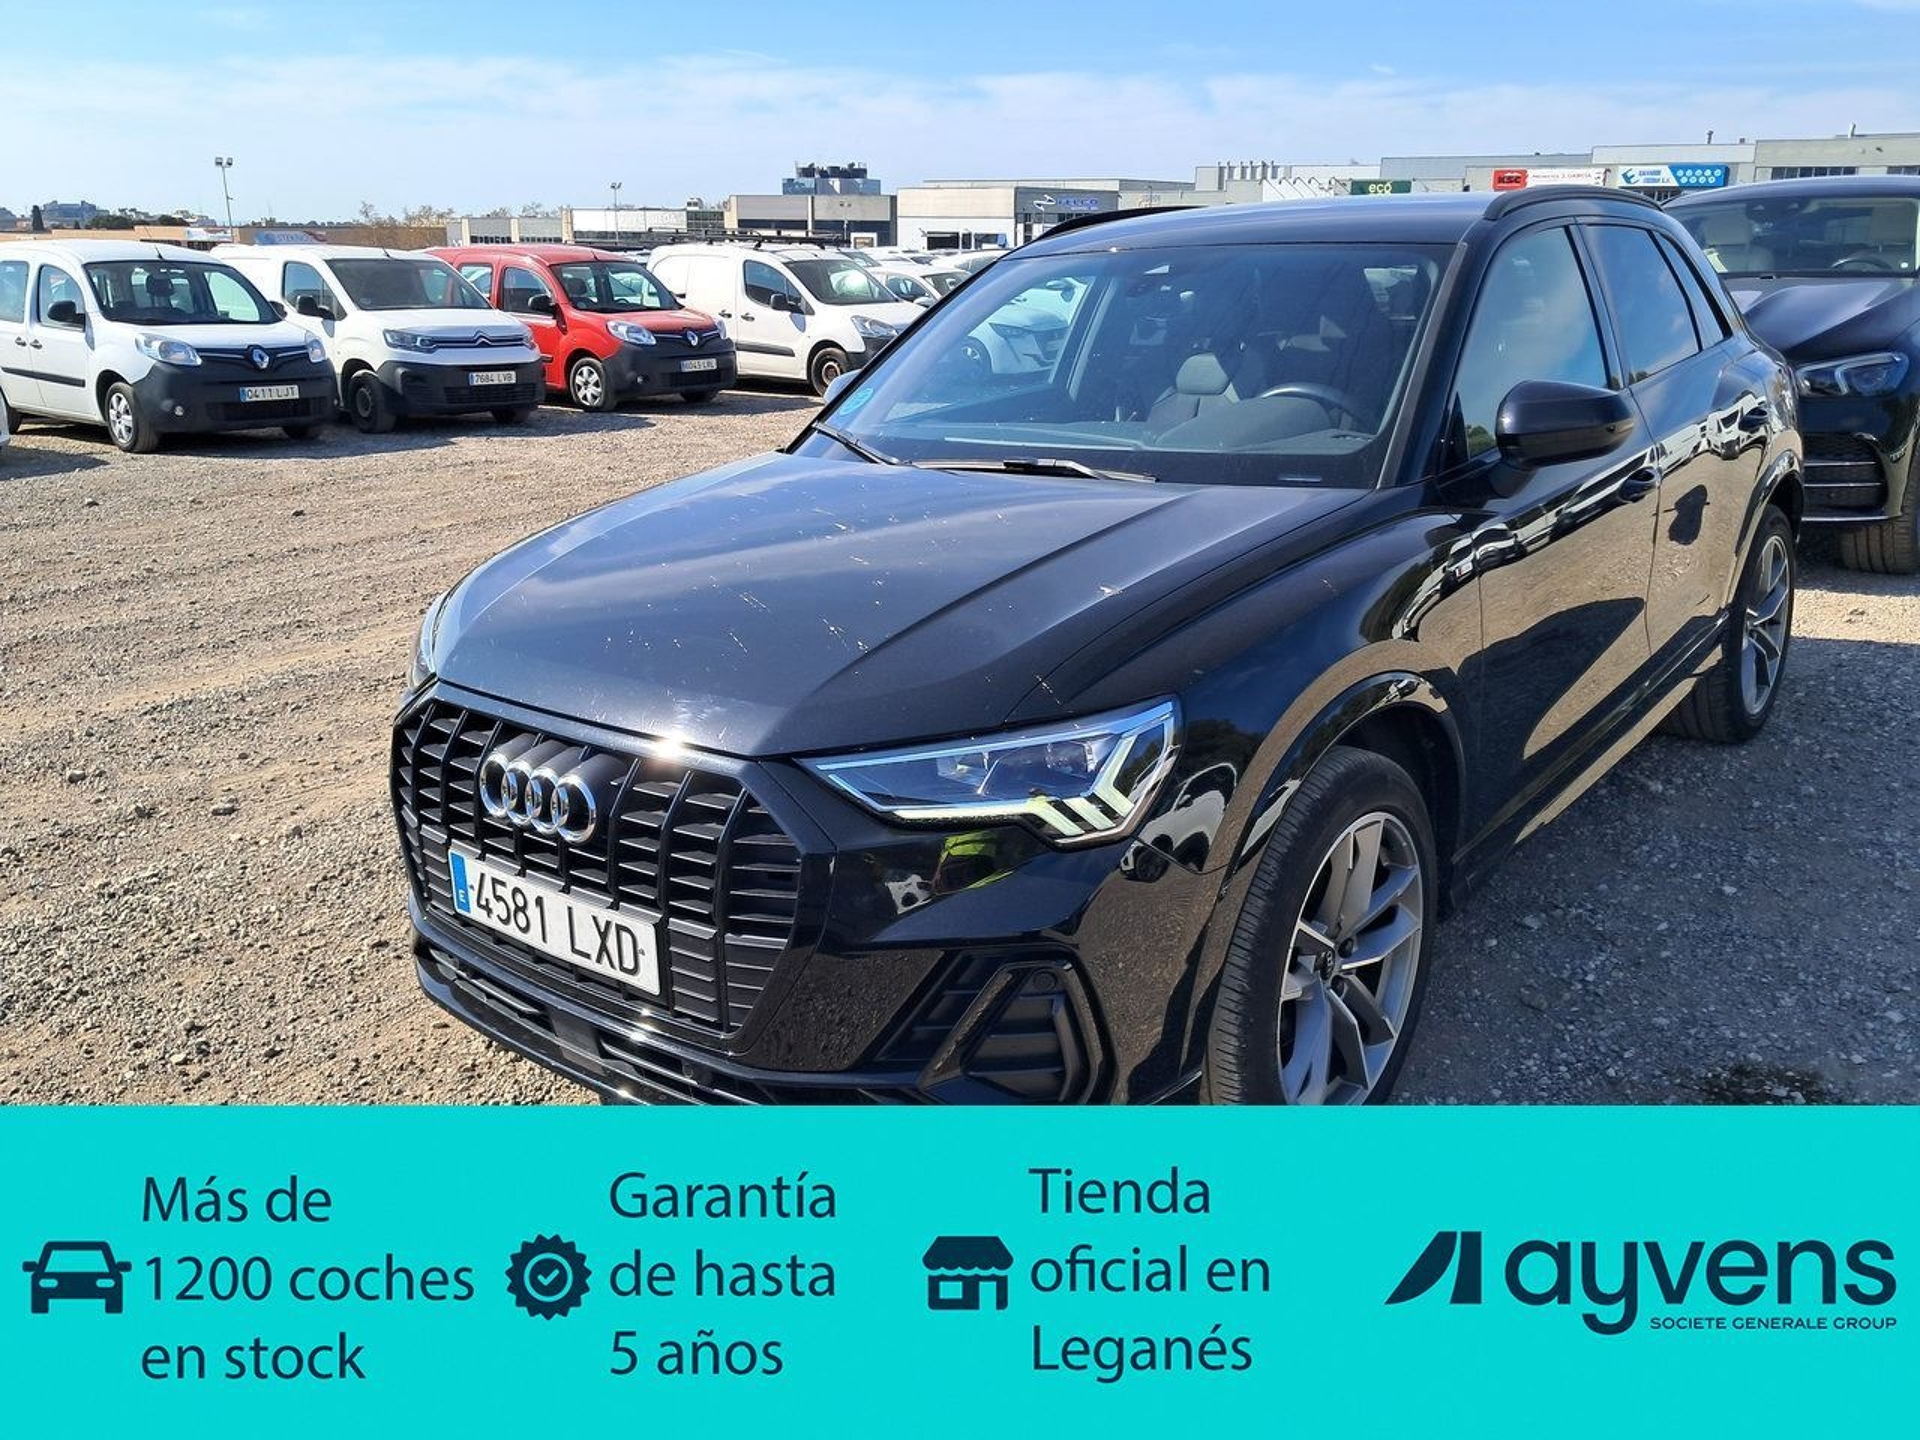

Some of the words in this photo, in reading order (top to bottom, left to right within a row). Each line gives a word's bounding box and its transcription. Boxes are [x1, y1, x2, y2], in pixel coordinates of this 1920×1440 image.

[1497, 175, 1522, 184] KSC
[475, 373, 495, 383] 7684
[247, 388, 272, 400] 0411
[476, 872, 548, 944] 4581
[567, 906, 640, 976] LXD
